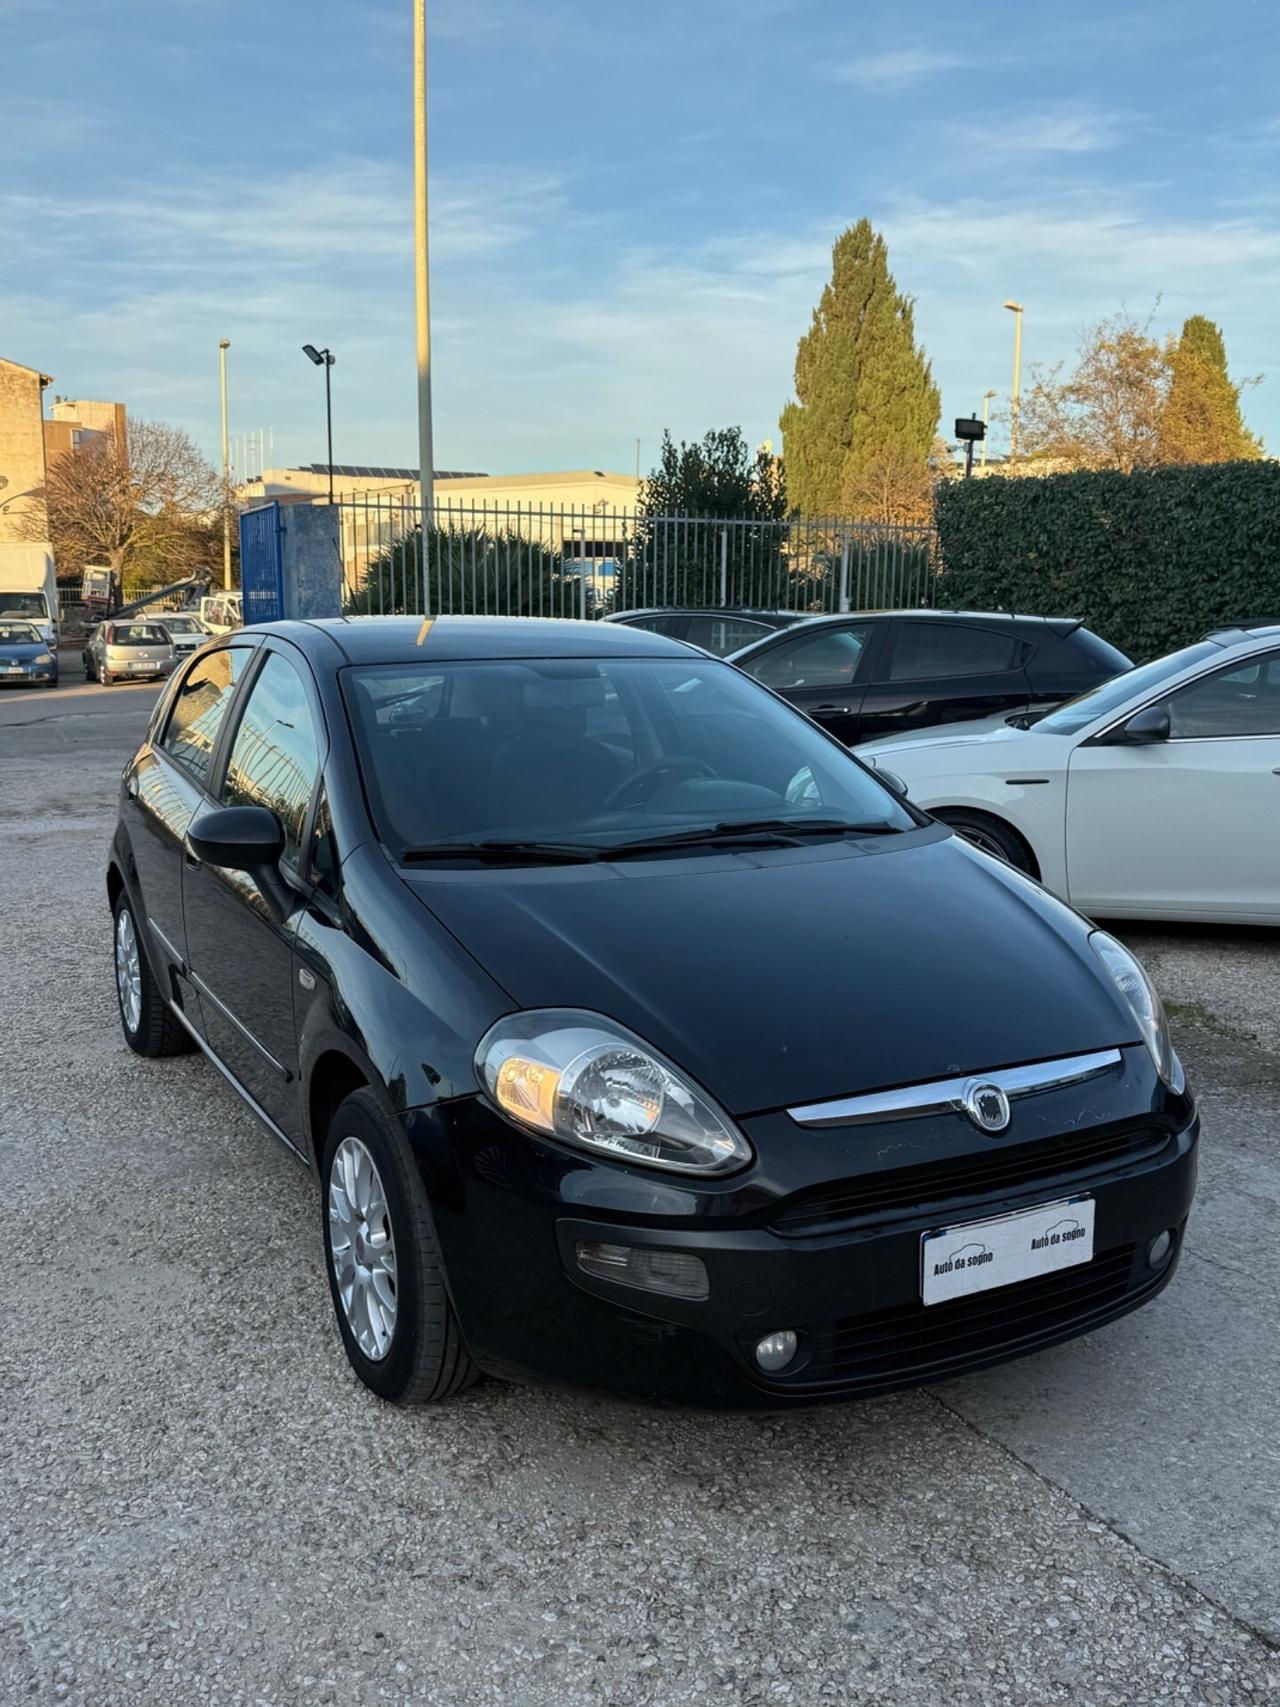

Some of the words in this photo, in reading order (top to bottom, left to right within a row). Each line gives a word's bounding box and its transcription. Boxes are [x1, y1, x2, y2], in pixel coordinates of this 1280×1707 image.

[1031, 1236, 1049, 1250] Auto
[1050, 1233, 1060, 1245] da
[1062, 1227, 1086, 1242] sogno
[934, 1261, 953, 1275] Auto
[954, 1258, 965, 1270] da
[967, 1252, 993, 1267] sogno
